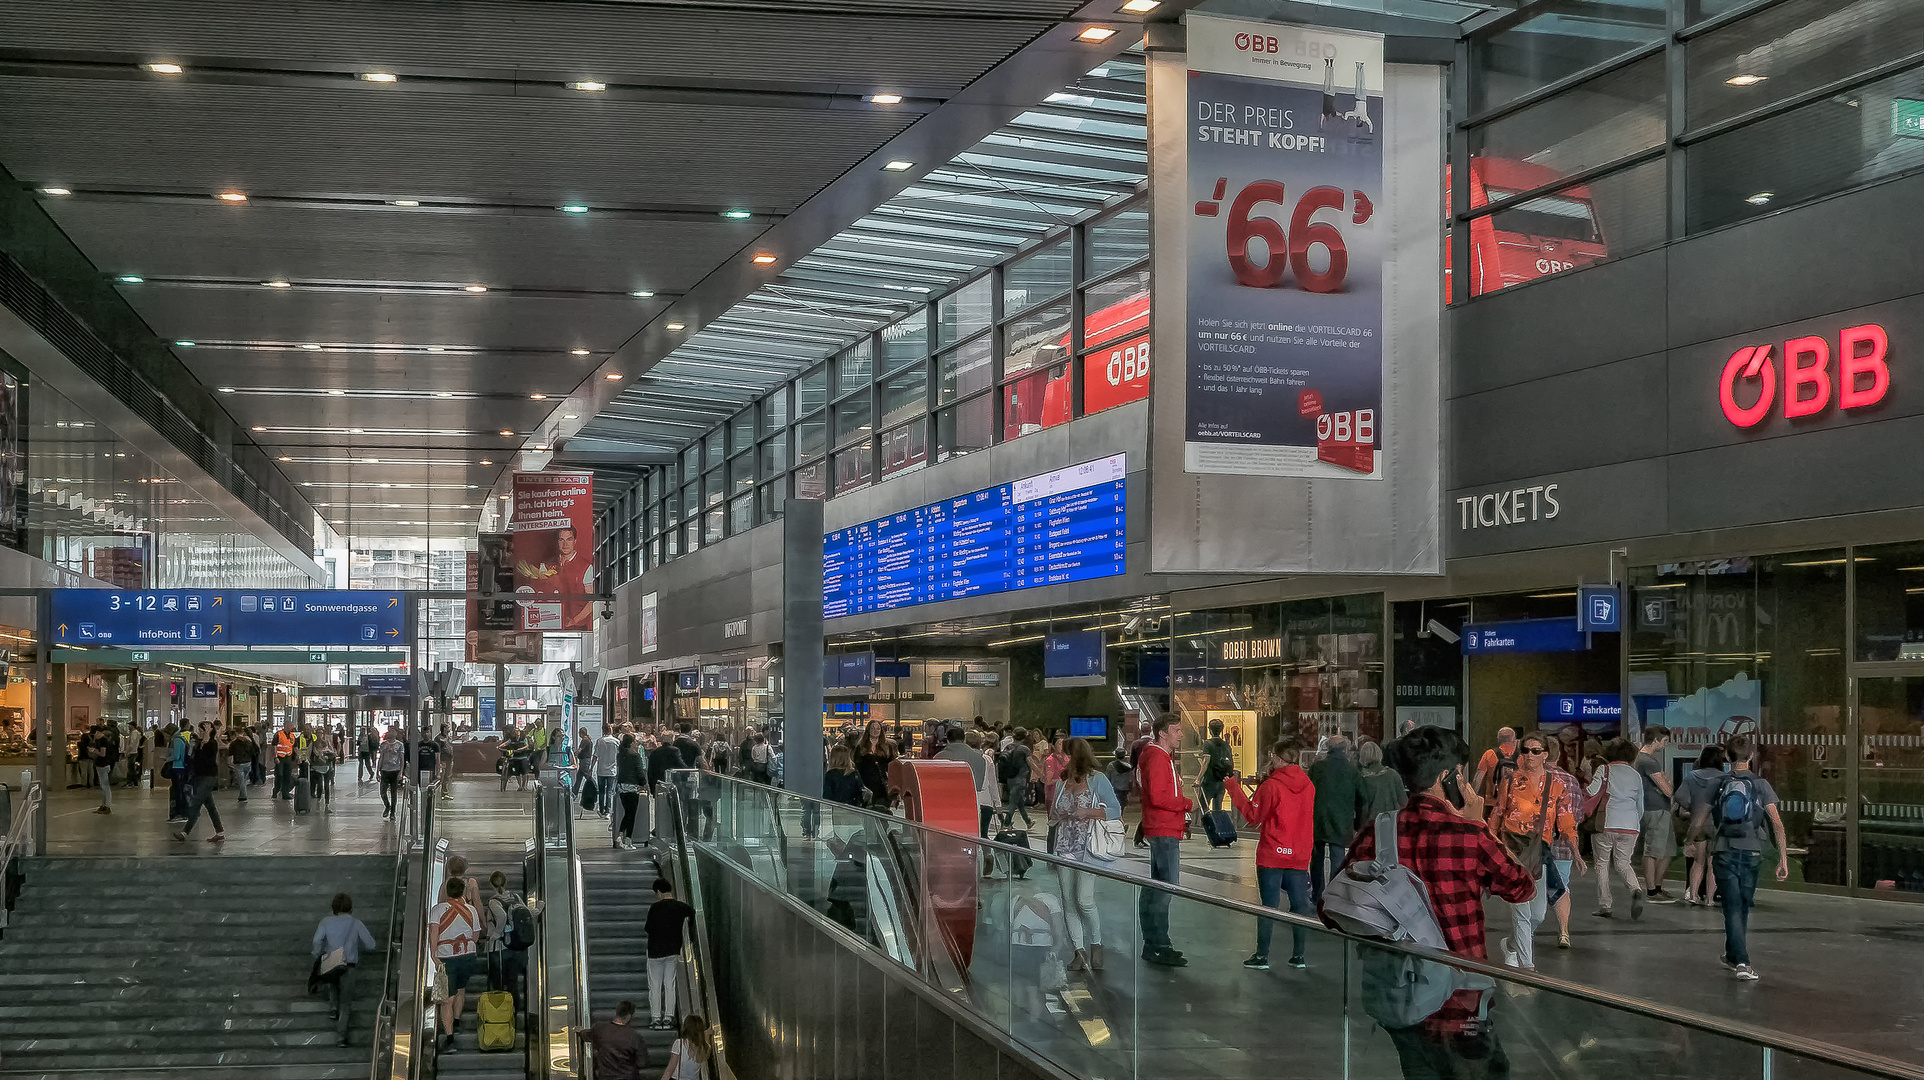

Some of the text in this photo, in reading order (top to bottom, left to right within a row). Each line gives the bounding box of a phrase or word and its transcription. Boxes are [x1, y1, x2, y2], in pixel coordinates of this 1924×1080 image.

[1234, 32, 1280, 54] ÖBB
[1252, 57, 1271, 65] Immer
[1280, 59, 1312, 70] Bewegung
[1198, 100, 1294, 130] DER PREIS
[1198, 125, 1325, 153] STEHT KOPF!
[1198, 318, 1373, 337] Holen Sie sich jetzt online die VORTEILSCARD 66
[1198, 332, 1212, 340] um
[1250, 333, 1264, 342] und
[1266, 334, 1291, 344] nutzen
[1293, 336, 1304, 345] Sie
[1305, 337, 1318, 346] alle
[1319, 337, 1347, 348] Vorteile
[1349, 339, 1361, 348] der
[1106, 342, 1150, 386] ÖBB
[1243, 365, 1253, 374] auf
[1290, 368, 1310, 378] sparen
[1720, 324, 1891, 430] ÖBB
[1203, 374, 1225, 382] flexibel
[1270, 376, 1285, 385] Bahn
[1286, 377, 1306, 386] fahren
[1203, 384, 1216, 392] und
[1217, 385, 1229, 393] das
[1235, 386, 1248, 394] Jahr
[1249, 386, 1263, 396] lang
[1317, 408, 1374, 444] ÖBB
[1197, 430, 1262, 439] oebb.at/VORTEILSCARD
[518, 487, 587, 500] Sie kaufen online
[518, 499, 575, 510] ein. Ich bring's
[1457, 483, 1560, 530] TICKETS
[518, 510, 565, 520] Ihnen heim.
[518, 519, 569, 530] INTERSPAR.AT
[305, 603, 378, 614] Sonnwendgasse
[139, 630, 181, 639] InfoPoint
[1484, 637, 1515, 647] Fahrkarten
[1223, 638, 1281, 660] BOBBI BROWN
[1396, 685, 1456, 696] BOBBI BROWN
[1583, 705, 1622, 715] Fahrkarten
